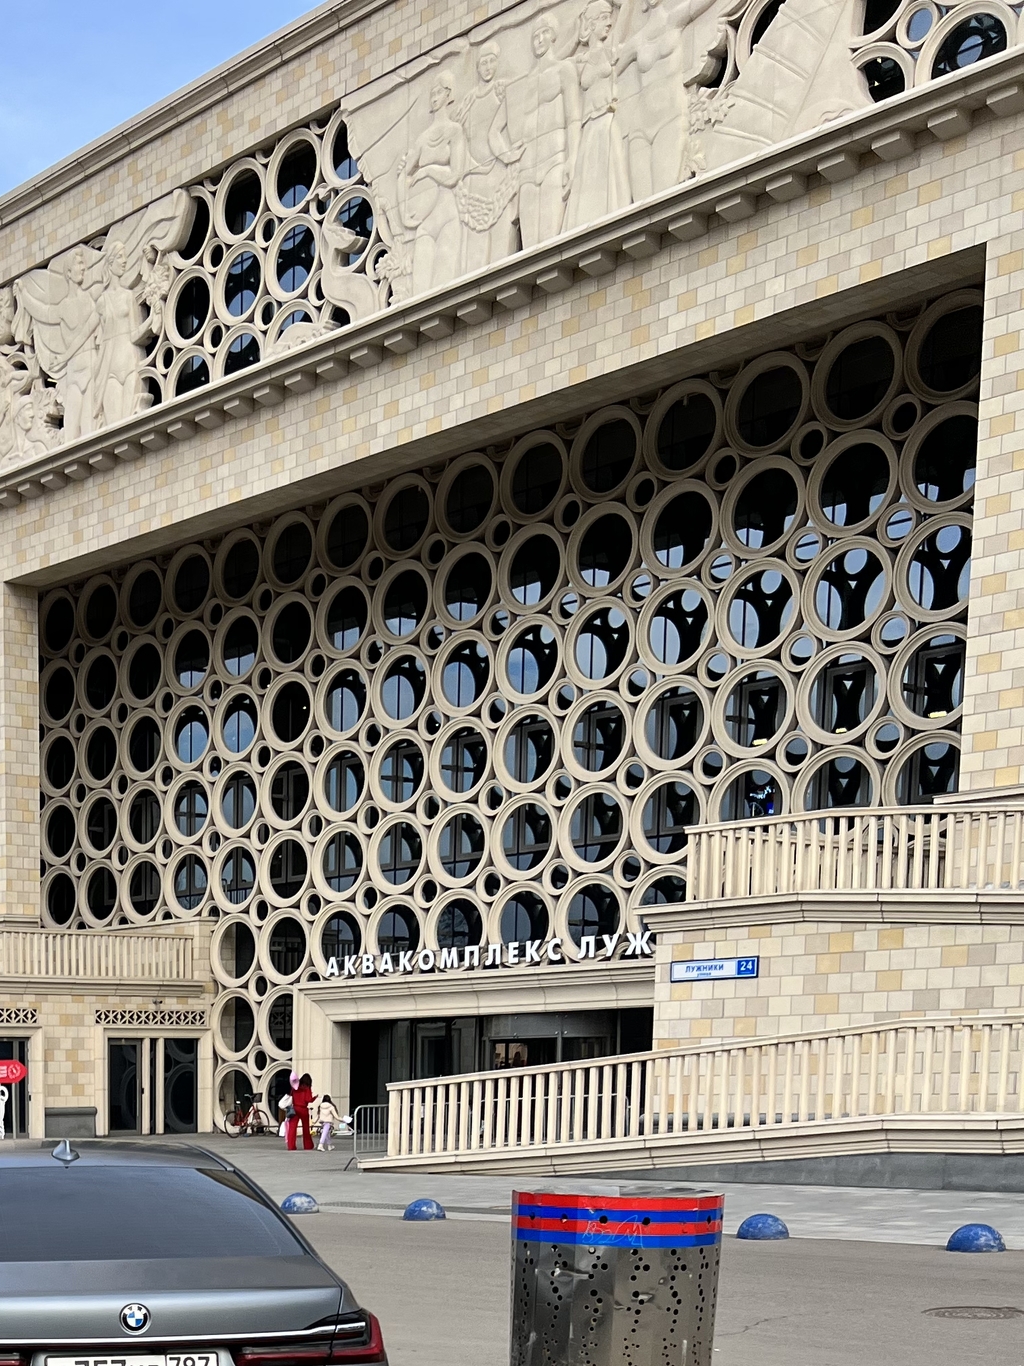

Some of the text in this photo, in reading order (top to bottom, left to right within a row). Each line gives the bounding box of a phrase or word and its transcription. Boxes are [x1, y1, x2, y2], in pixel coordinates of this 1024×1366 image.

[326, 938, 563, 977] АКВАКОМПЛЕКС
[685, 964, 724, 973] ЛУЖНИКИ
[740, 961, 753, 971] 24
